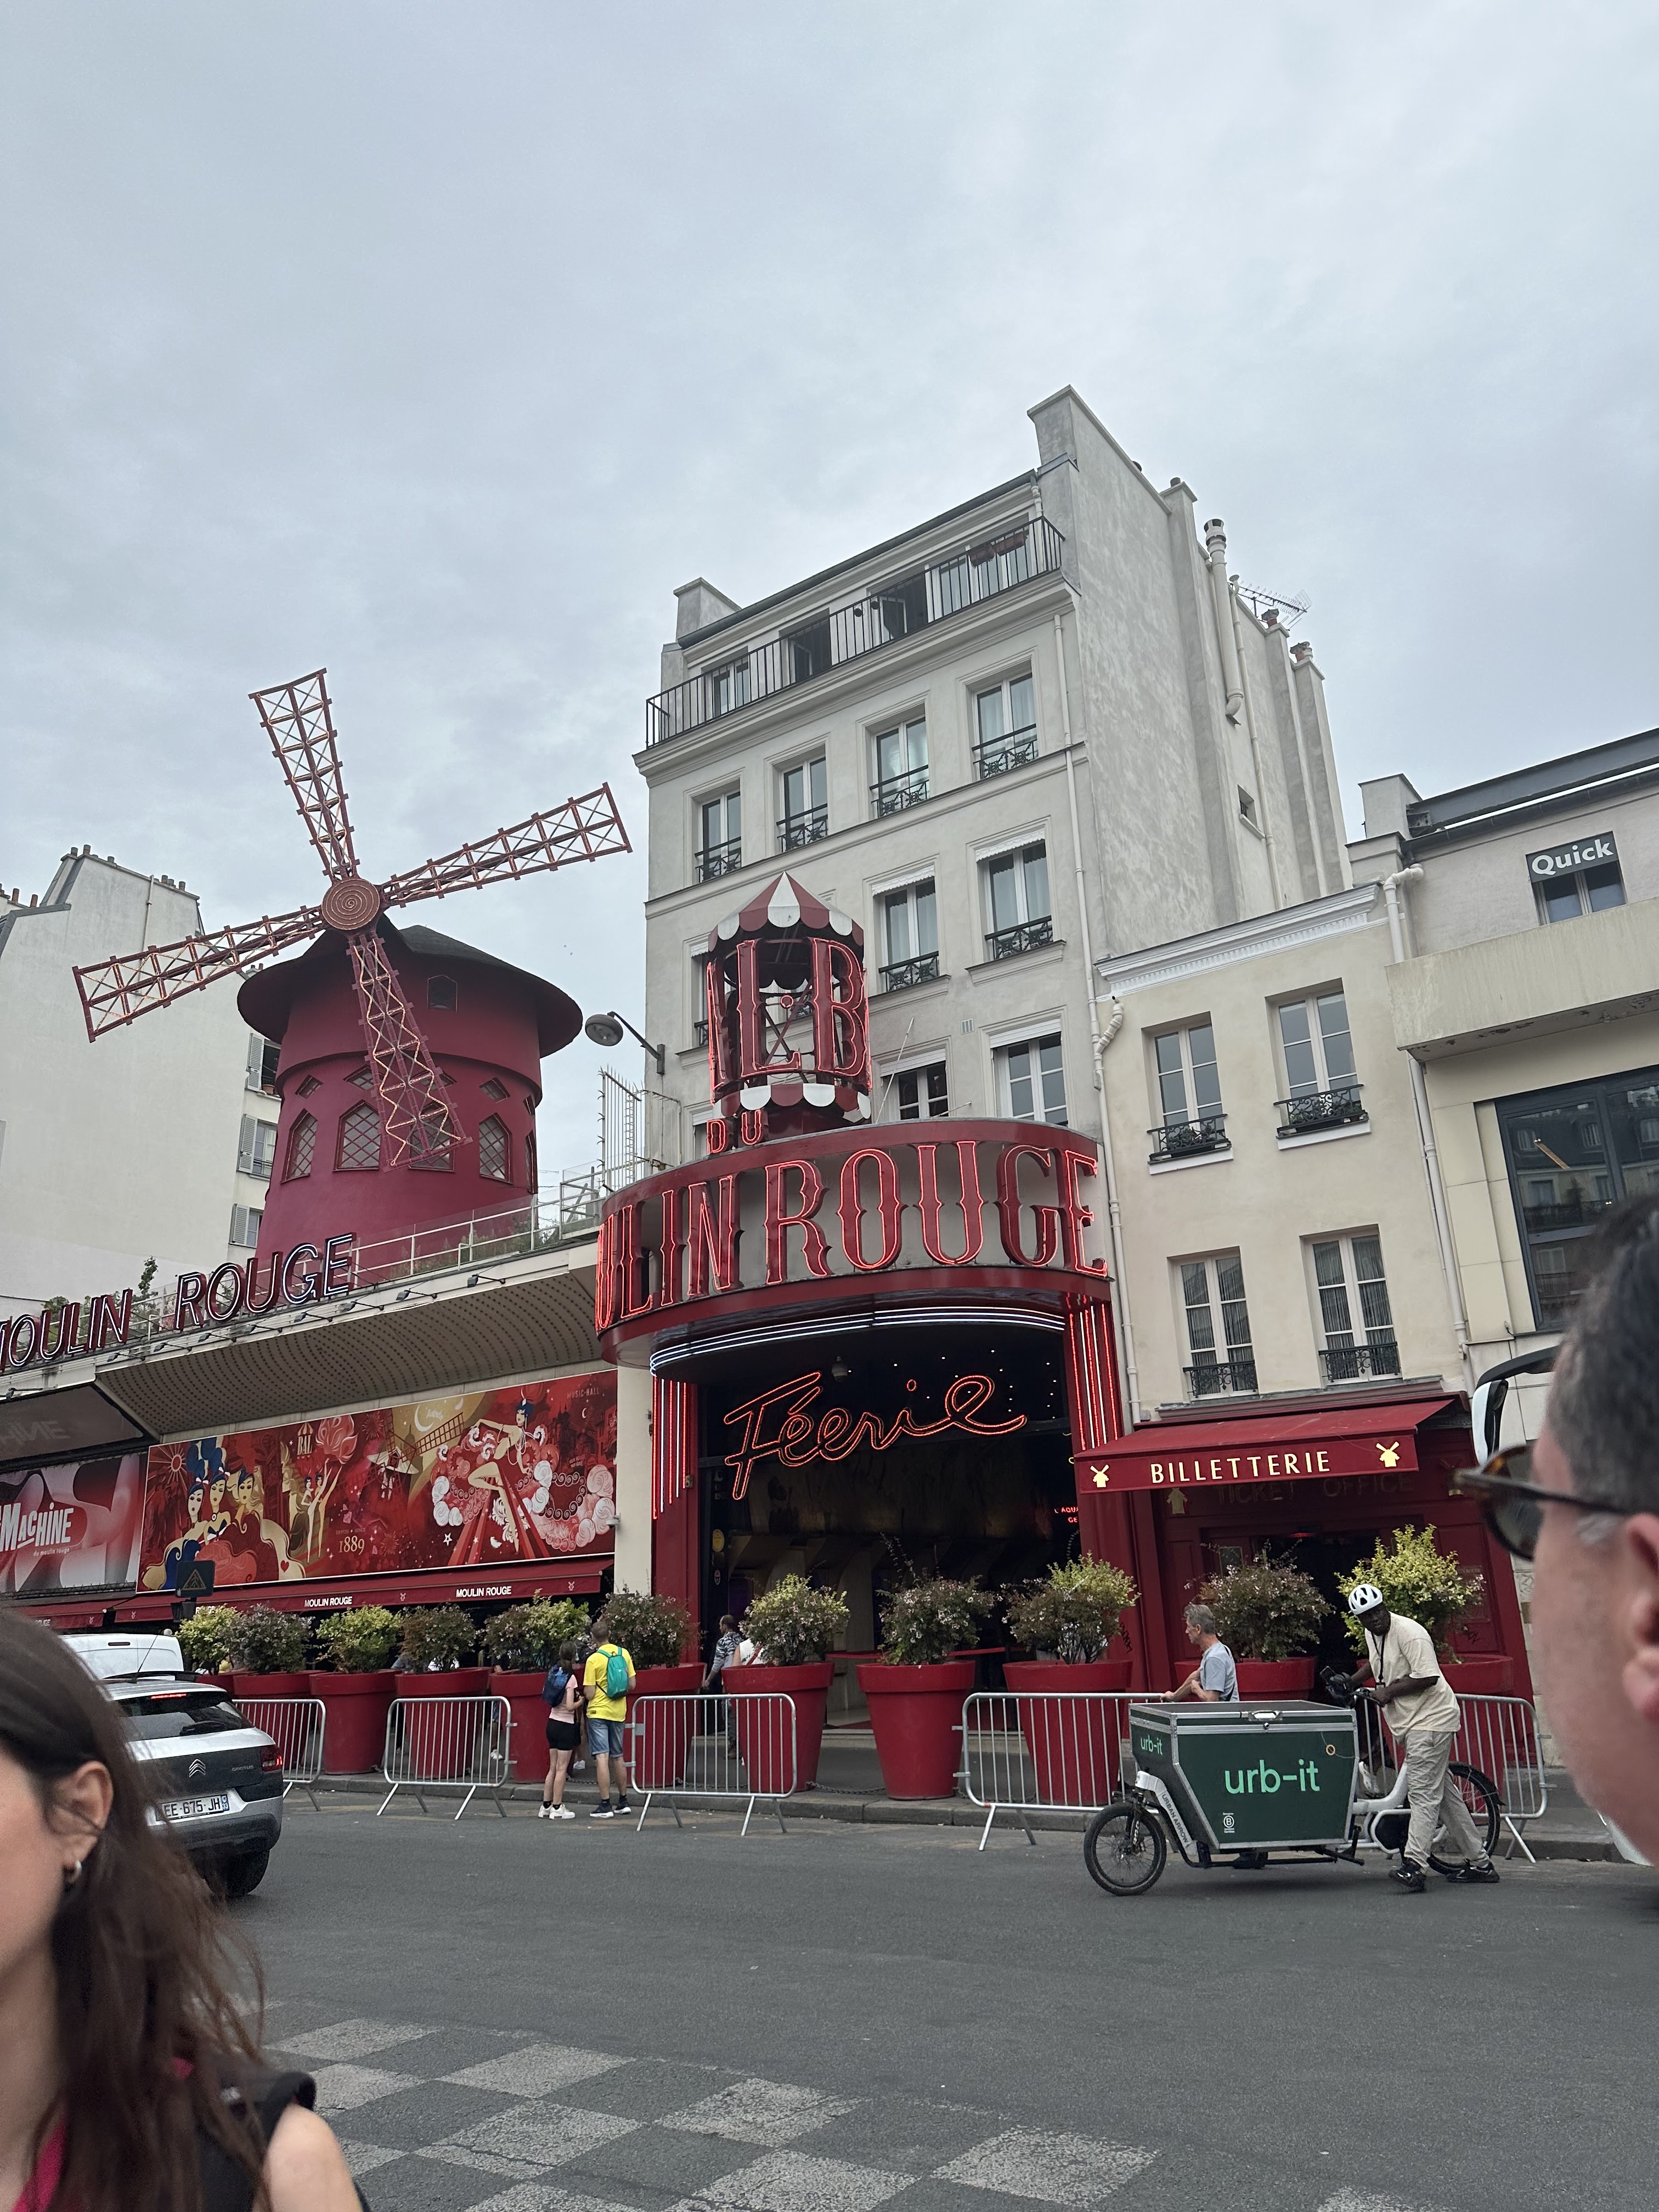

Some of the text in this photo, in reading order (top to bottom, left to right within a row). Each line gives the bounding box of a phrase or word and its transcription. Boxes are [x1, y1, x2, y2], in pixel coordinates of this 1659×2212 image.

[1532, 839, 1614, 875] Quick
[707, 1109, 763, 1155] DU
[595, 1141, 1108, 1336] ULIN ROUGE
[173, 1232, 357, 1331] ROUGE
[297, 1435, 312, 1455] BAL
[724, 1372, 1028, 1500] Féerie
[1151, 1451, 1330, 1483] BILLETTERIE
[1214, 1474, 1414, 1505] TICKET OFFICE
[338, 1536, 365, 1555] 1889
[304, 1596, 353, 1607] MOULIN ROUGE
[456, 1586, 512, 1598] MOULIN ROUGE
[1141, 1735, 1163, 1756] urb-it
[1224, 1759, 1320, 1794] urb-it
[1161, 1794, 1190, 1843] URBAN ARROW
